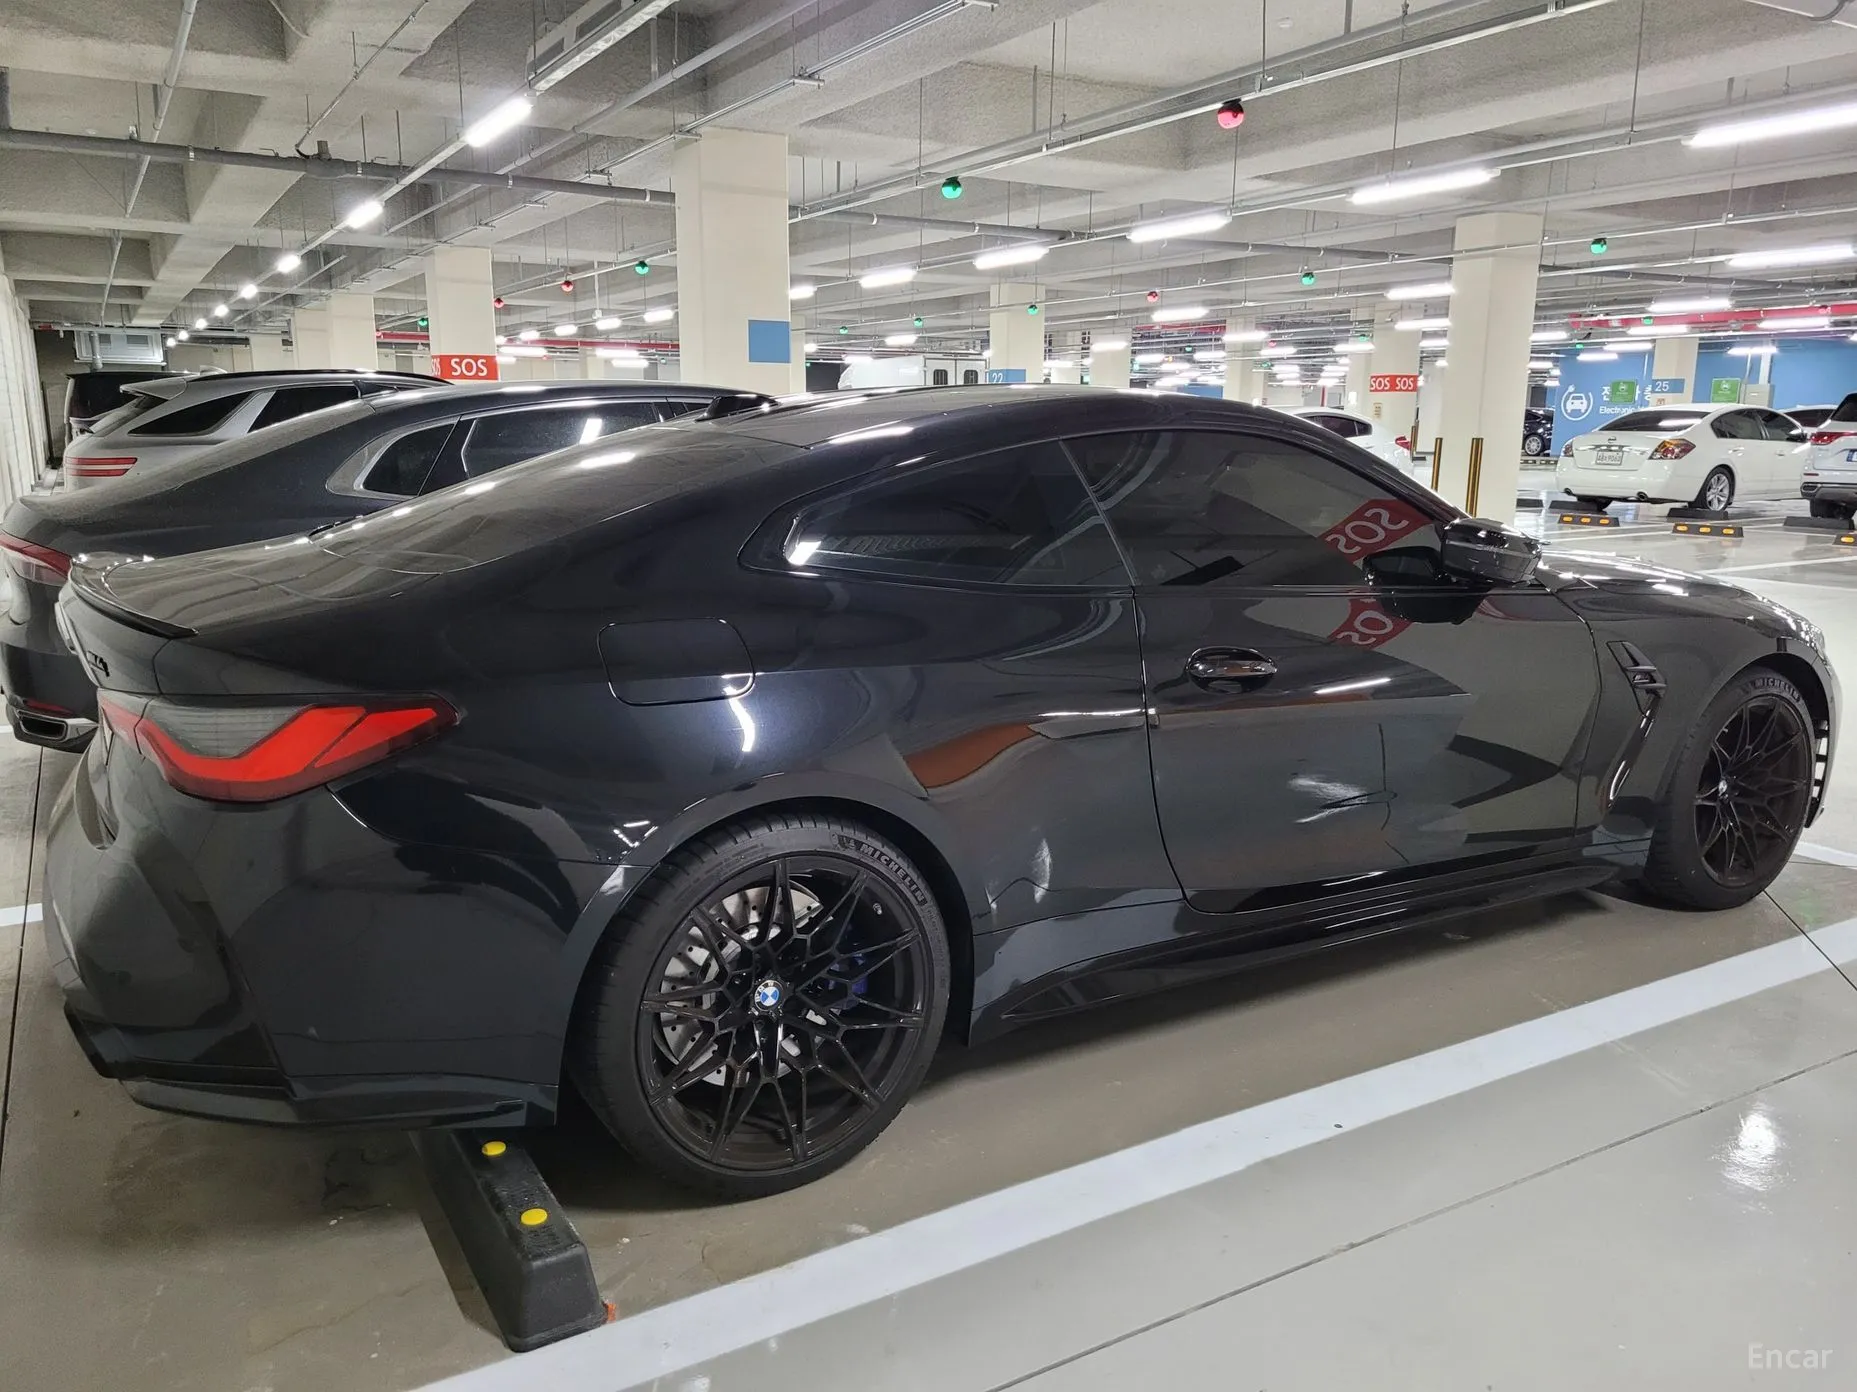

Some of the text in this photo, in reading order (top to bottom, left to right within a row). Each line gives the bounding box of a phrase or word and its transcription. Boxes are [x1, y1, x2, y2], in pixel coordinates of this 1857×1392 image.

[450, 357, 488, 377] SOS
[1370, 377, 1391, 390] SOS
[1395, 377, 1414, 390] SOS
[1654, 381, 1669, 392] 25
[1755, 677, 1800, 700] MICHELIN
[861, 843, 926, 903] MICHELIN
